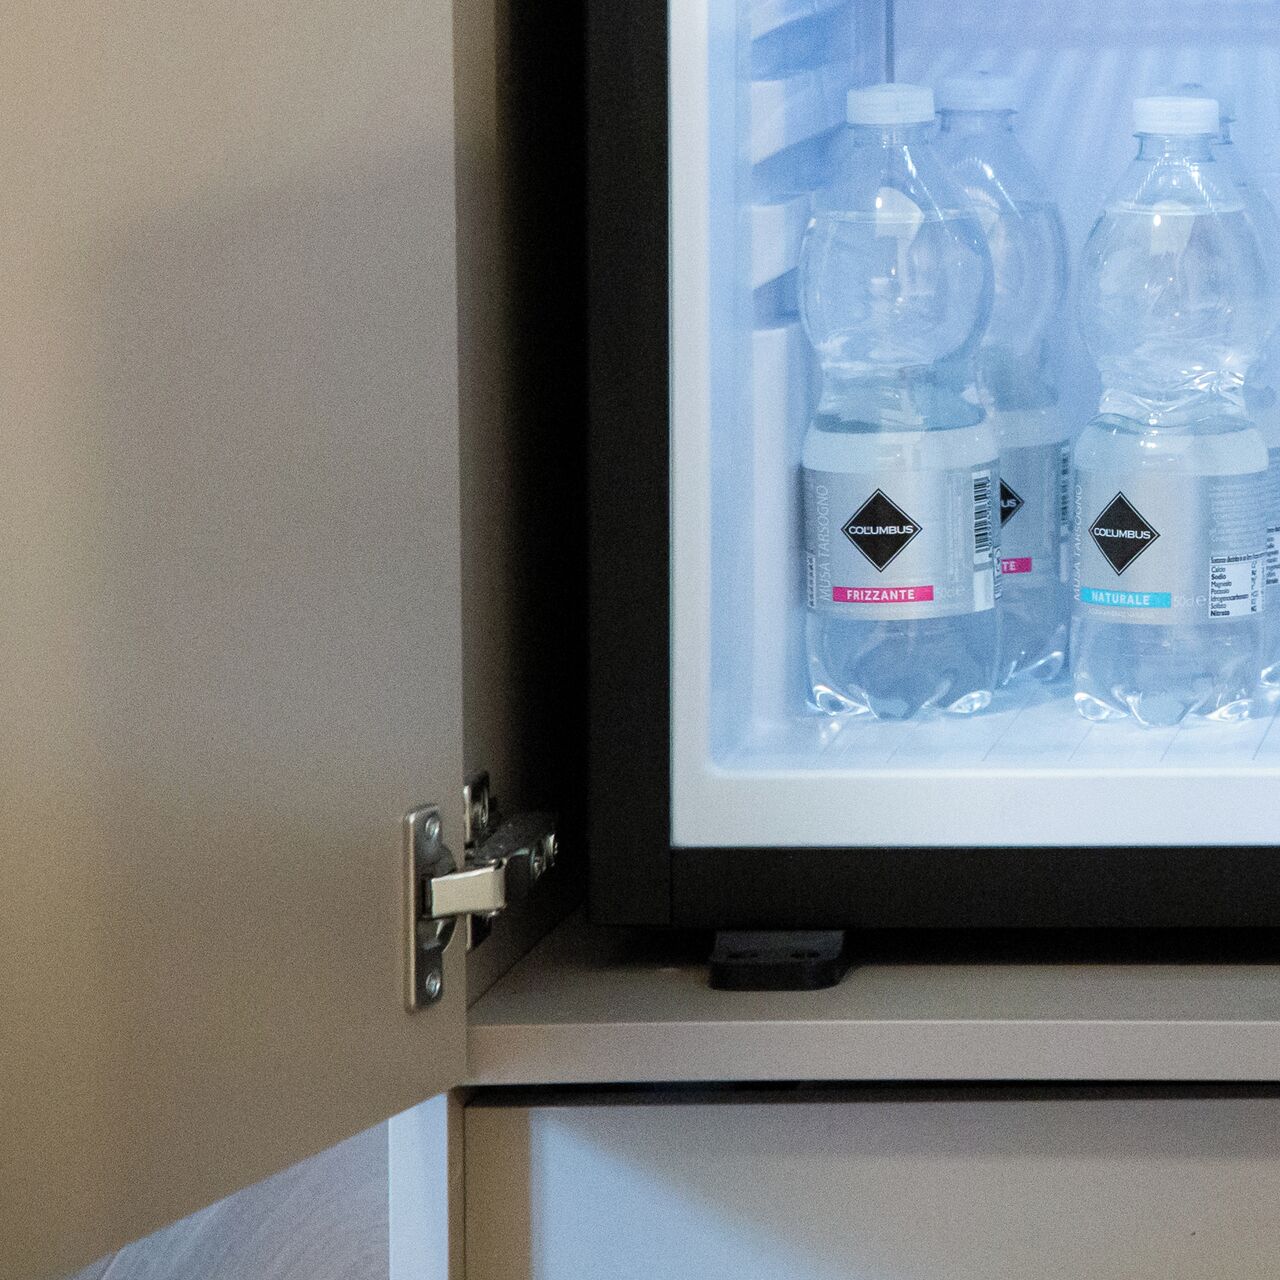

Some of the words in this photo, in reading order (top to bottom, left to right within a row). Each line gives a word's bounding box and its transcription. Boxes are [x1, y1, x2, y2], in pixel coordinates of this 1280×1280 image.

[816, 485, 830, 558] TARSOGNO
[848, 525, 914, 535] COLUMBUS
[1093, 527, 1151, 539] COLUMBUS
[818, 563, 832, 601] MUSA
[846, 589, 915, 601] FRIZZANTE
[1091, 590, 1151, 606] NATURALE
